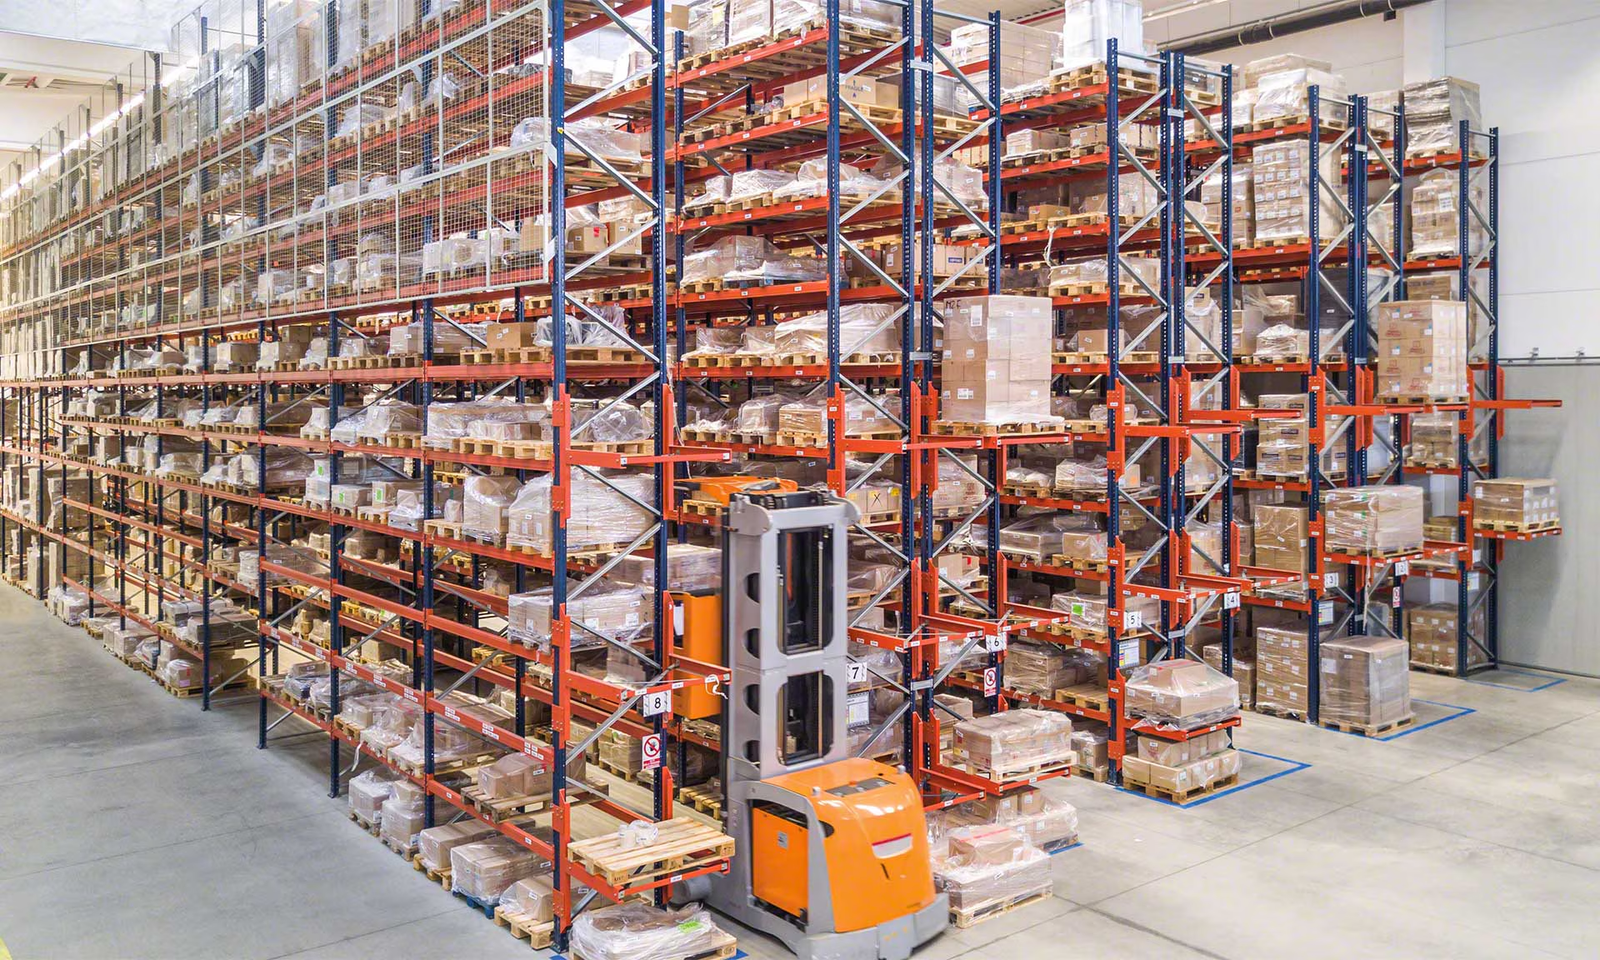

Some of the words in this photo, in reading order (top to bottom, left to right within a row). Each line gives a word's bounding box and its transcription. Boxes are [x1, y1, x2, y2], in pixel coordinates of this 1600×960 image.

[1329, 575, 1334, 584] 3
[1130, 615, 1135, 625] 5
[994, 637, 1000, 647] 6
[852, 667, 859, 679] 7
[654, 697, 661, 709] 8
